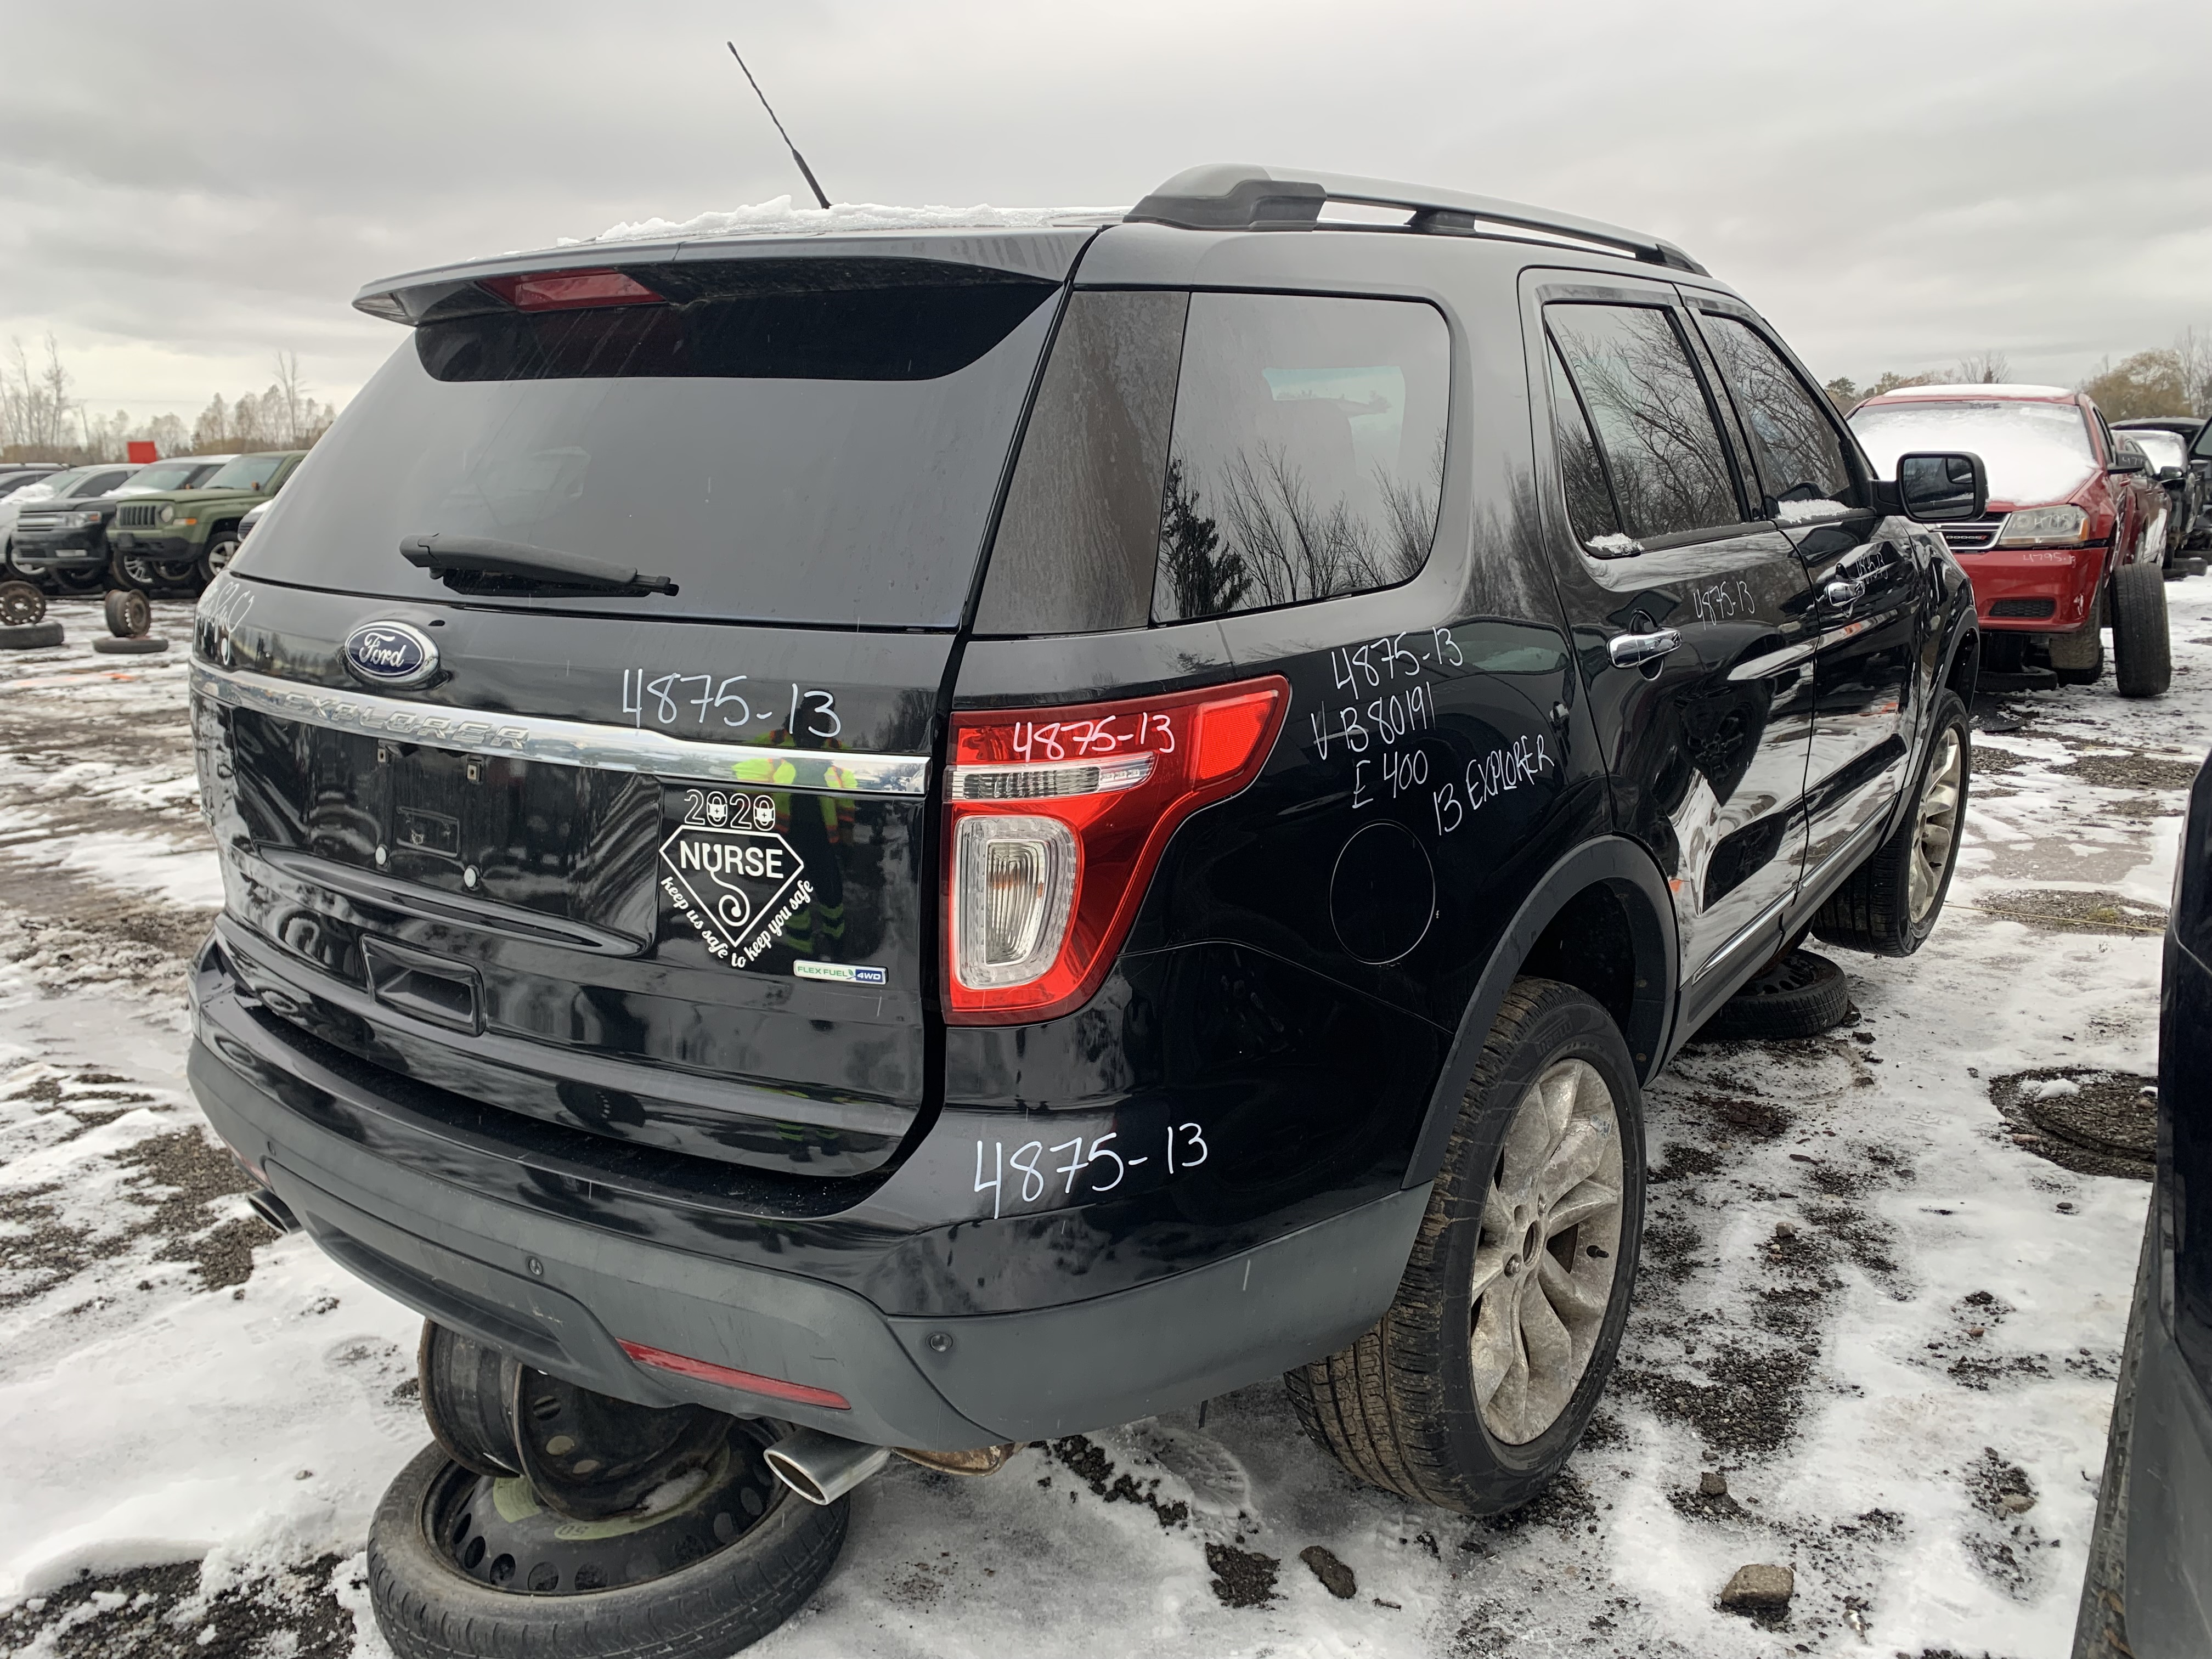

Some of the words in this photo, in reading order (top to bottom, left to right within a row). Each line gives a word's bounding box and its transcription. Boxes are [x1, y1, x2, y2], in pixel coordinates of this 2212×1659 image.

[359, 632, 407, 668] Ford
[1331, 627, 1463, 699] 4875-13
[283, 691, 531, 750] EXPLORER
[623, 668, 842, 738] 4875-13
[1012, 712, 1175, 763] 4875-13
[1384, 749, 1428, 799] 400
[1433, 783, 1463, 836] 13
[1465, 733, 1555, 810] EXPLORER
[684, 789, 776, 832] 2020
[680, 840, 784, 879] NURSE
[661, 876, 689, 910] keep
[686, 909, 704, 930] us
[701, 929, 729, 958] safe
[731, 952, 747, 968] to
[743, 930, 772, 962] keep
[768, 905, 792, 937] you
[789, 879, 814, 911] safe
[797, 966, 822, 975] FLEX
[823, 969, 848, 977] FUEL
[856, 972, 881, 980] 4WD
[974, 1122, 1208, 1220] 4875-13
